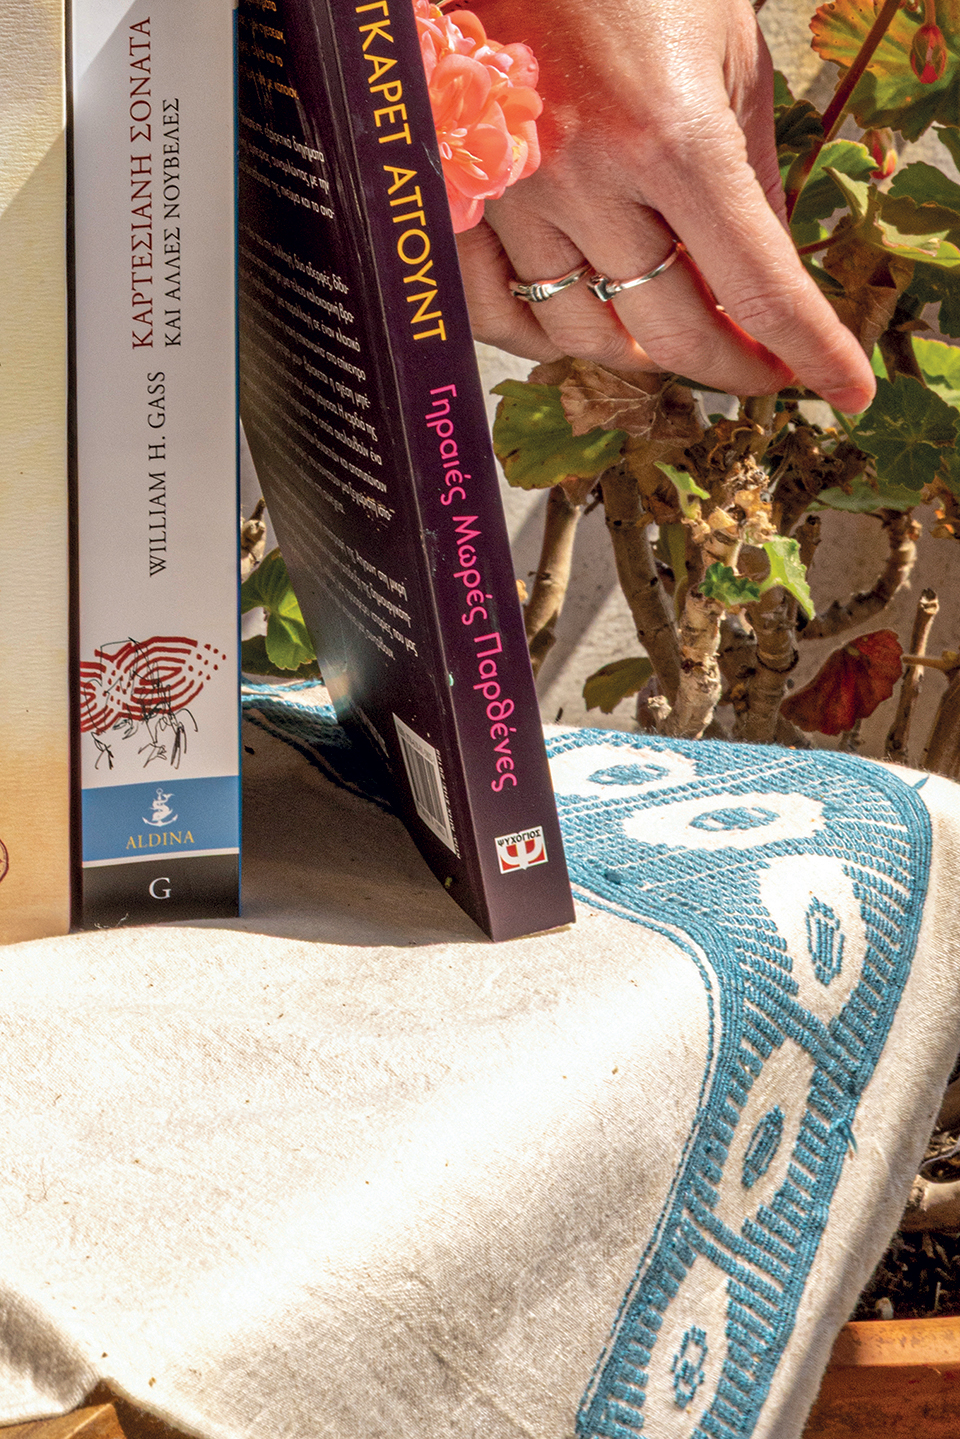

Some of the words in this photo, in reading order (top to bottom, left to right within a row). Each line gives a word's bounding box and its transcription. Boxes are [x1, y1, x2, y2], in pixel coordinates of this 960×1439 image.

[130, 17, 152, 140] ΣΟΝΑΤΑ
[163, 97, 181, 221] ΝΟΥΒΕΛΕΣ
[131, 153, 153, 349] ΚΑΡΤΕΣΙΑΝΗ
[164, 227, 181, 299] ΑΛΛΕΣ
[383, 165, 447, 341] ΑΤΓΟΥΝΤ
[164, 302, 181, 347] ΚΑΙ
[147, 371, 166, 430] GASS
[149, 435, 166, 461] H.
[425, 384, 472, 506] Γηραιές
[149, 471, 167, 577] WILLIAM
[447, 514, 494, 626] Μωρές
[473, 632, 518, 792] Παρθένες
[125, 830, 195, 850] ALDINA
[148, 877, 171, 900] G
[497, 829, 541, 847] ΨΥΧΟΓΙΟΣ
